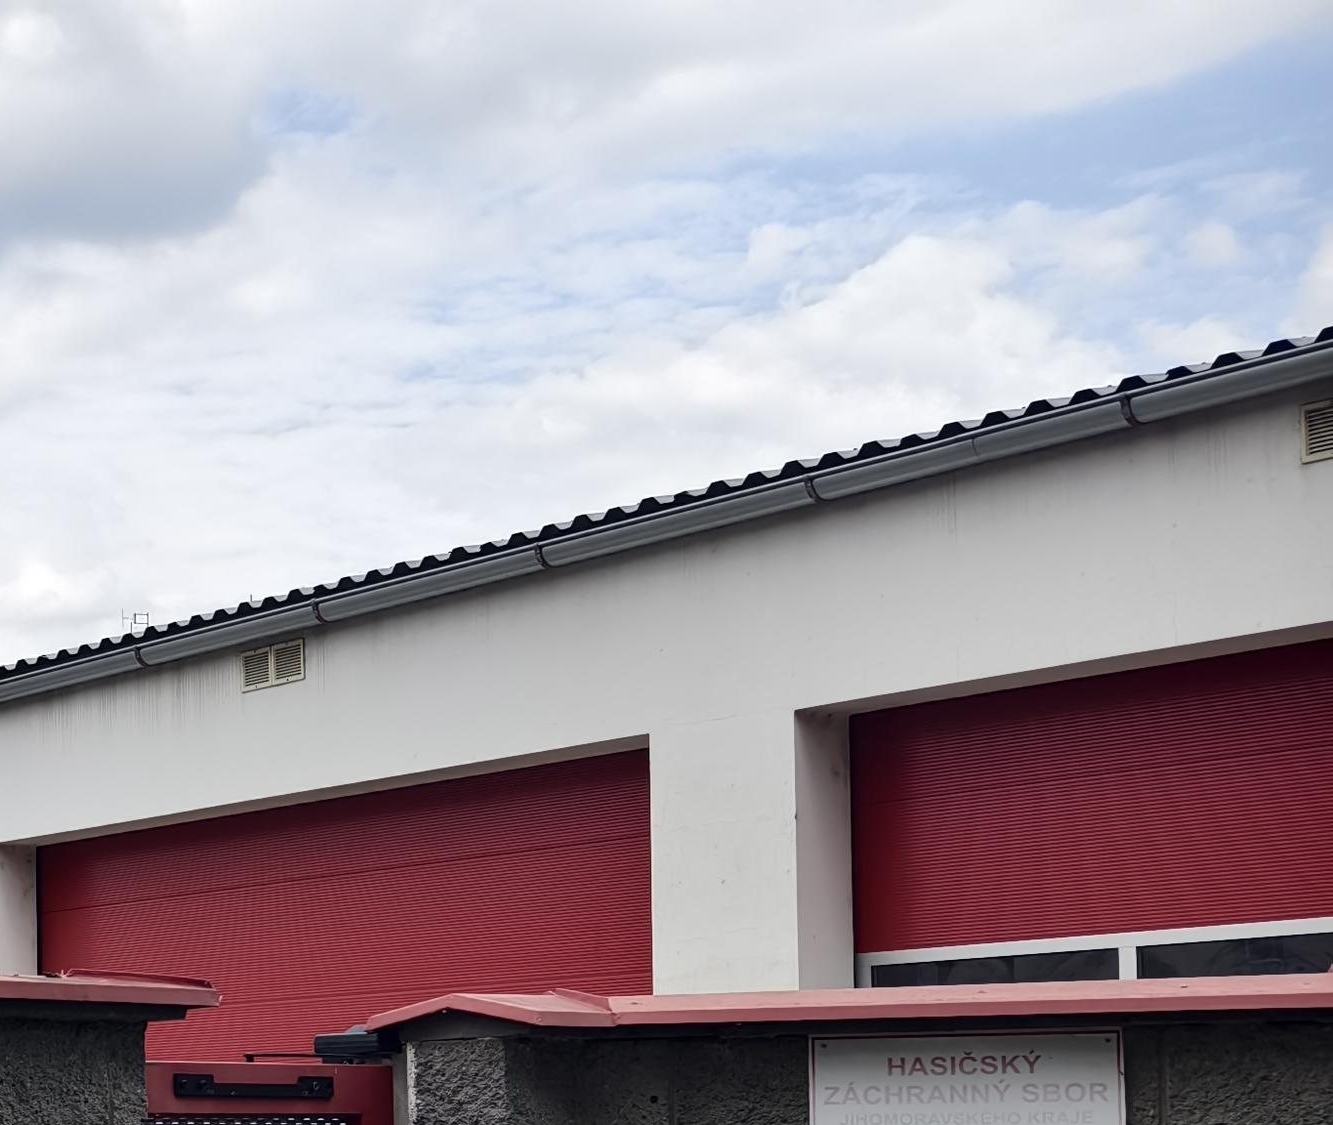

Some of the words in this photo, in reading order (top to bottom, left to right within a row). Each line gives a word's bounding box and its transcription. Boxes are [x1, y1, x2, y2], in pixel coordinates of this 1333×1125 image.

[887, 1049, 1042, 1077] HASIČSKÝ
[823, 1079, 1011, 1106] ZÁCHRANNÝ
[1021, 1082, 1109, 1103] SBOR
[1028, 1110, 1094, 1125] KRAJE
